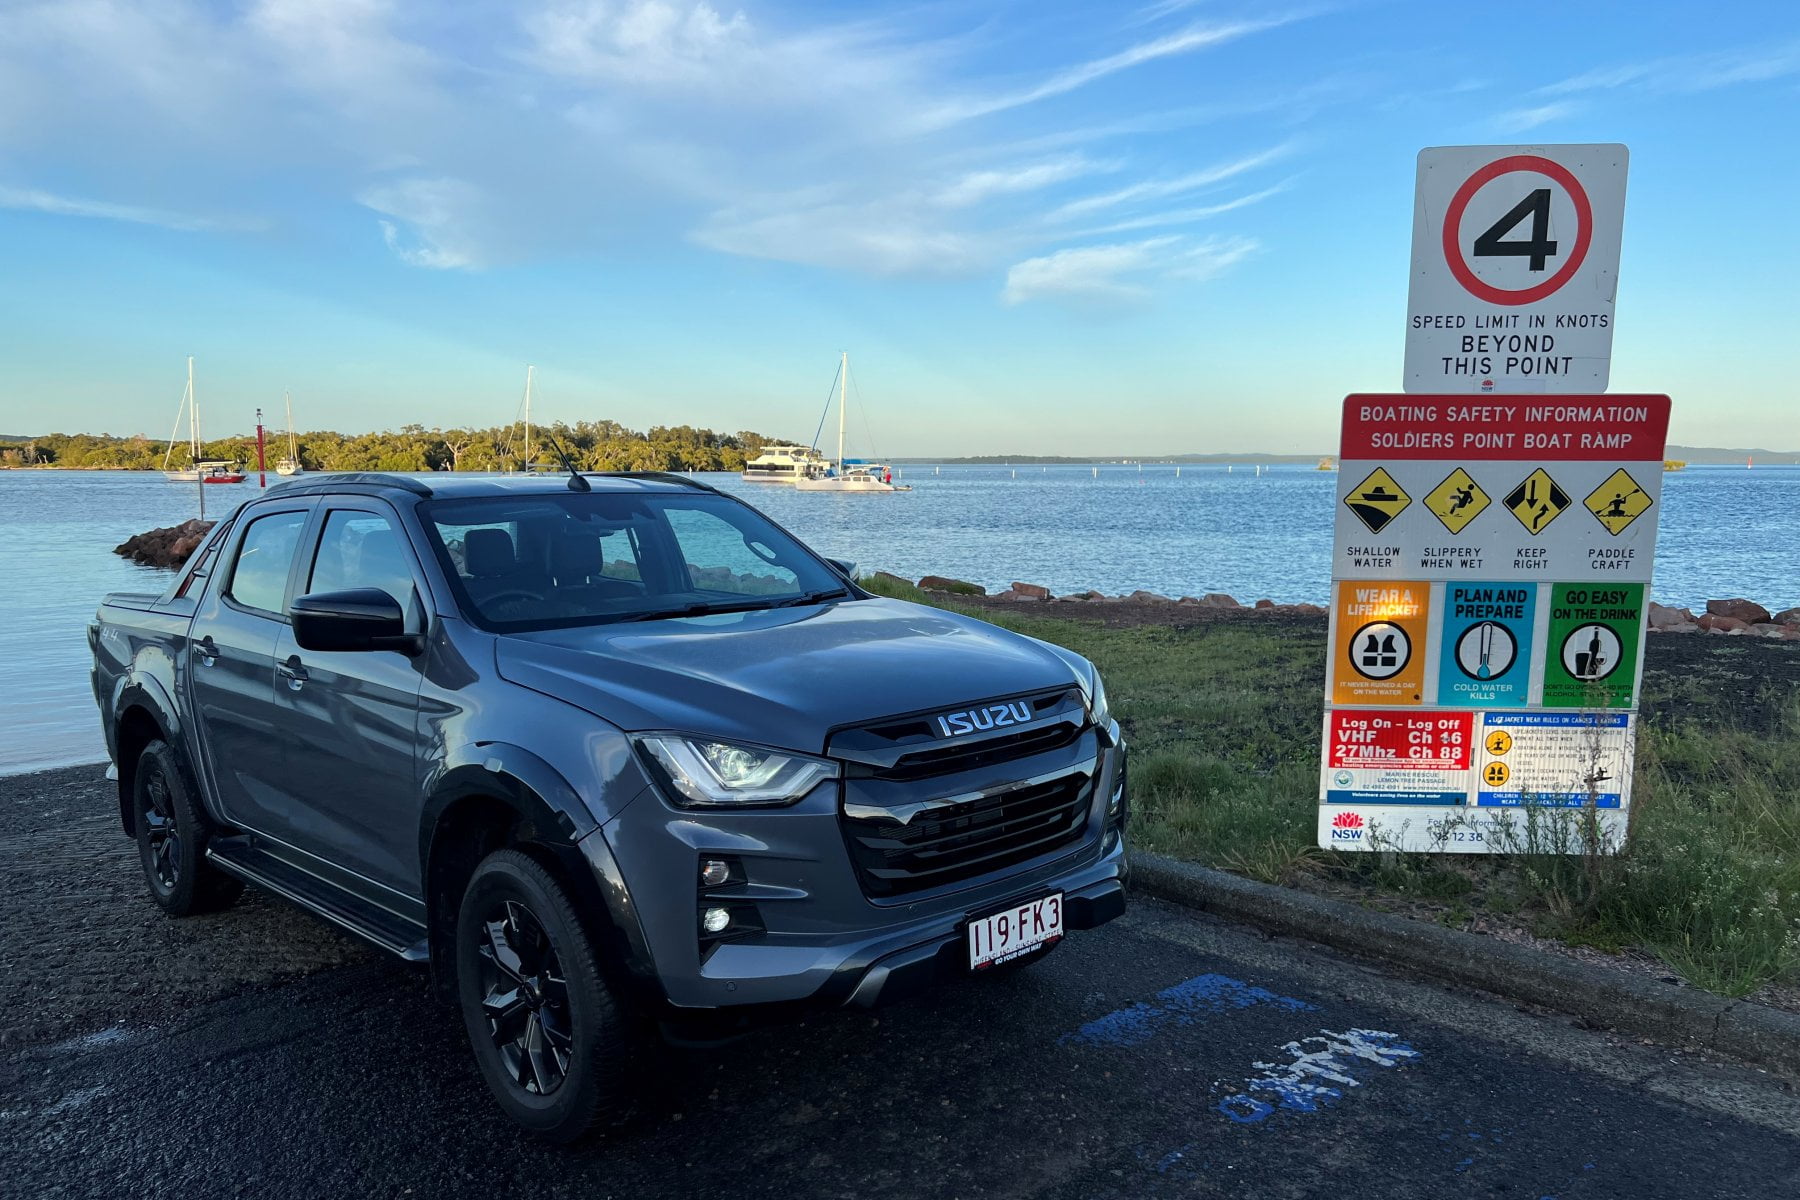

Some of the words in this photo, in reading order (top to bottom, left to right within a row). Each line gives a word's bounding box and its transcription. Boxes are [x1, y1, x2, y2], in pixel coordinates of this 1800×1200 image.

[1473, 188, 1558, 271] 4
[1412, 315, 1466, 329] SPEED
[1475, 314, 1519, 329] LIMIT
[1528, 314, 1545, 329] IN
[1555, 314, 1609, 328] KNOTS
[1461, 335, 1554, 353] BEYOND
[1442, 357, 1492, 375] THIS
[1505, 356, 1573, 375] POINT
[1360, 406, 1437, 422] BOATING
[1446, 406, 1517, 422] SAFETY
[1525, 406, 1648, 423] INFORMATION
[1370, 432, 1454, 448] SOLDIERS
[1463, 433, 1515, 449] POINT
[1523, 433, 1572, 449] BOAT
[1580, 433, 1633, 449] RAMP
[1347, 546, 1400, 557] SHALLOW
[1423, 547, 1481, 558] SLIPPERY
[1516, 548, 1547, 558] KEEP
[1588, 548, 1635, 559] PADDLE
[1354, 558, 1392, 568] WATER
[1420, 559, 1453, 569] WHEN
[1460, 559, 1483, 569] WET
[1513, 559, 1549, 569] RIGHT
[1591, 560, 1631, 570] CRAFT
[1356, 588, 1399, 603] WEAR
[1400, 588, 1413, 603] A
[1454, 588, 1493, 603] PLAN
[1496, 589, 1528, 603] AND
[1566, 590, 1588, 605] GO
[1591, 590, 1629, 605] EASY
[1347, 604, 1419, 616] LIFEJACKET
[1455, 604, 1524, 619] PREPARE
[1553, 608, 1572, 620] ON
[1574, 608, 1597, 620] THE
[1600, 608, 1638, 620] DRINK
[1453, 683, 1479, 691] COLD
[1481, 684, 1513, 692] WATER
[1470, 692, 1496, 700] KILLS
[938, 701, 1031, 737] ISUZU
[1342, 718, 1368, 730] Log
[1372, 719, 1392, 729] On
[1407, 719, 1433, 730] Log
[1437, 719, 1461, 729] Off
[1337, 730, 1377, 743] VHF
[1408, 731, 1433, 744] Ch
[1440, 732, 1462, 744] 16
[1335, 744, 1397, 758] 27Mhz
[1408, 746, 1433, 758] Ch
[1439, 746, 1462, 759] 88
[1332, 829, 1363, 839] NSW
[1453, 832, 1465, 841] 12
